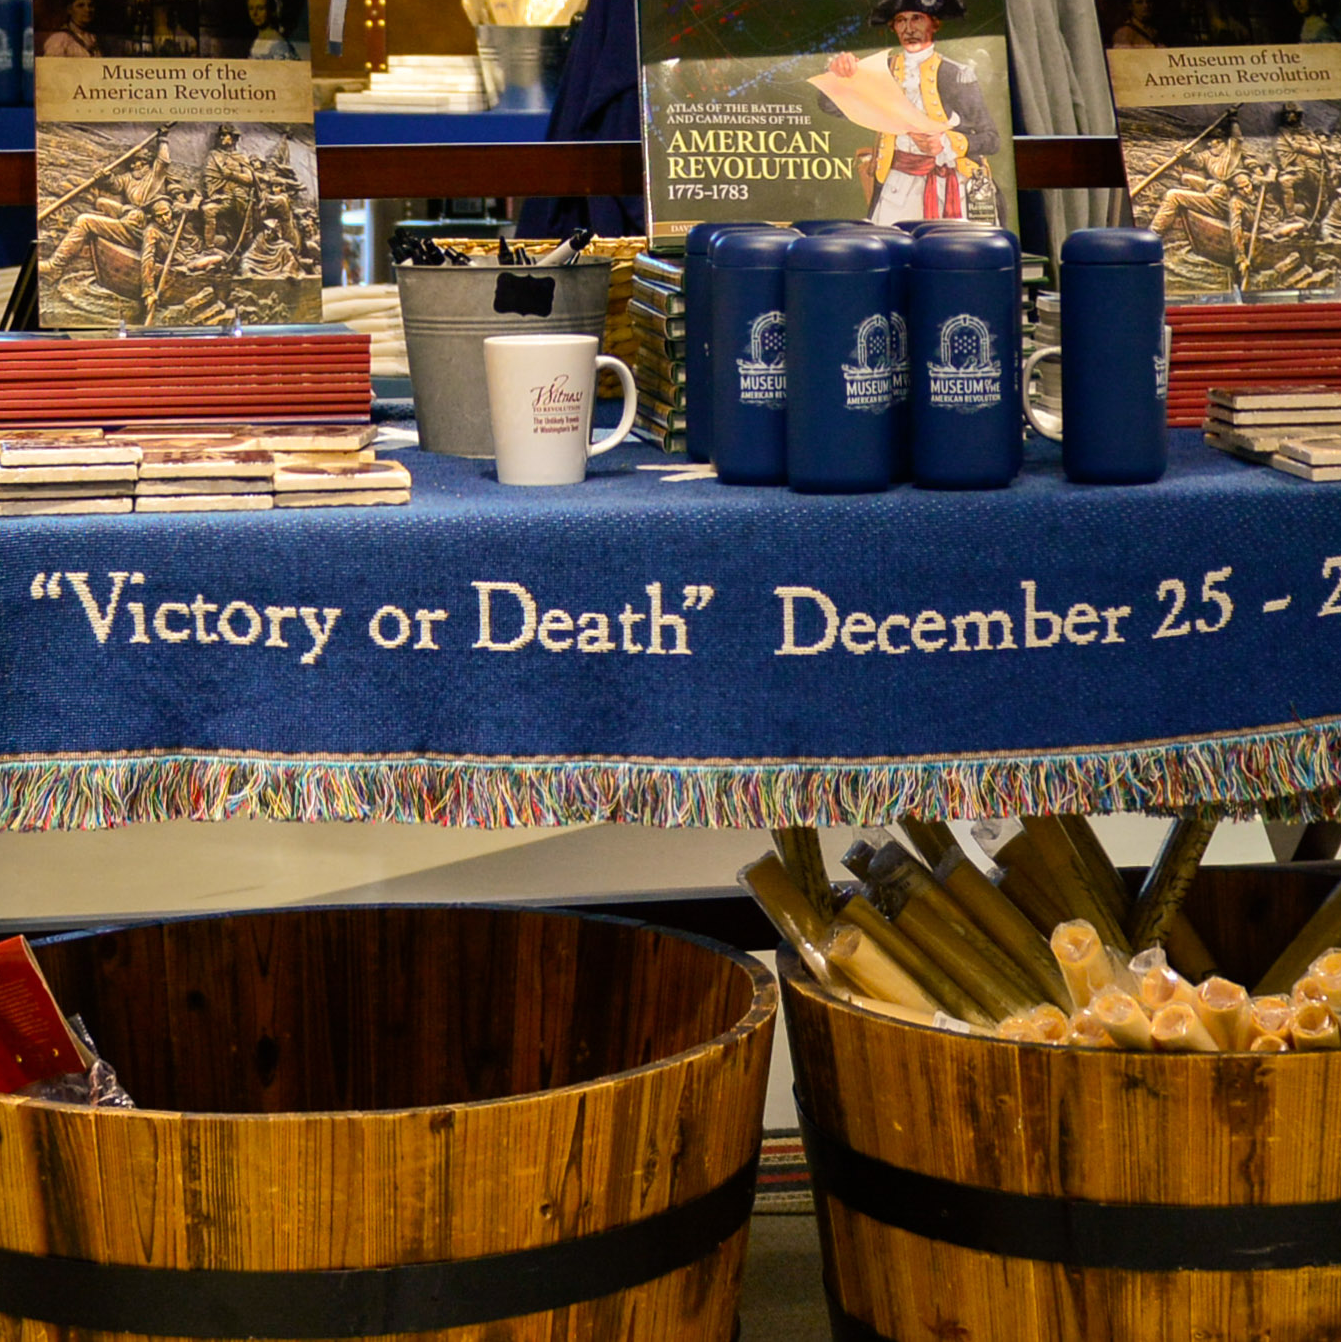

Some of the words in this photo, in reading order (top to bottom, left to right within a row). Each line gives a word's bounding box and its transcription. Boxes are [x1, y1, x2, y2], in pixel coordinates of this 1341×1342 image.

[1168, 53, 1245, 68] Museum
[1250, 49, 1268, 64] of
[1272, 49, 1301, 64] the
[102, 64, 186, 80] Museum
[192, 63, 212, 80] of
[217, 64, 247, 81] the
[1144, 69, 1232, 87] American
[1236, 66, 1331, 84] Revolution
[72, 84, 168, 100] American
[174, 84, 277, 101] Revolution
[1182, 90, 1230, 99] OFFICIAL
[1234, 88, 1297, 97] GUIDEBOOK
[112, 107, 163, 115] OFFICIAL
[169, 107, 239, 115] GUIDEBOOK
[667, 103, 704, 113] ATLAS
[706, 103, 722, 113] OF
[724, 103, 749, 113] THE
[751, 104, 803, 114] BATTLES
[667, 114, 694, 124] AND
[696, 115, 767, 125] CAMPAIGNS
[768, 115, 786, 125] OF
[787, 115, 811, 125] THE
[666, 130, 831, 154] AMERICAN
[667, 156, 853, 180] REVOLUTION
[530, 374, 583, 406] Witness
[930, 378, 983, 394] MUSEUM
[533, 417, 543, 425] The
[545, 416, 564, 425] Unlikely
[30, 570, 342, 665] “Victory
[368, 604, 448, 651] or
[471, 579, 715, 656] Death”
[774, 579, 1133, 656] December
[1149, 565, 1234, 641] 25
